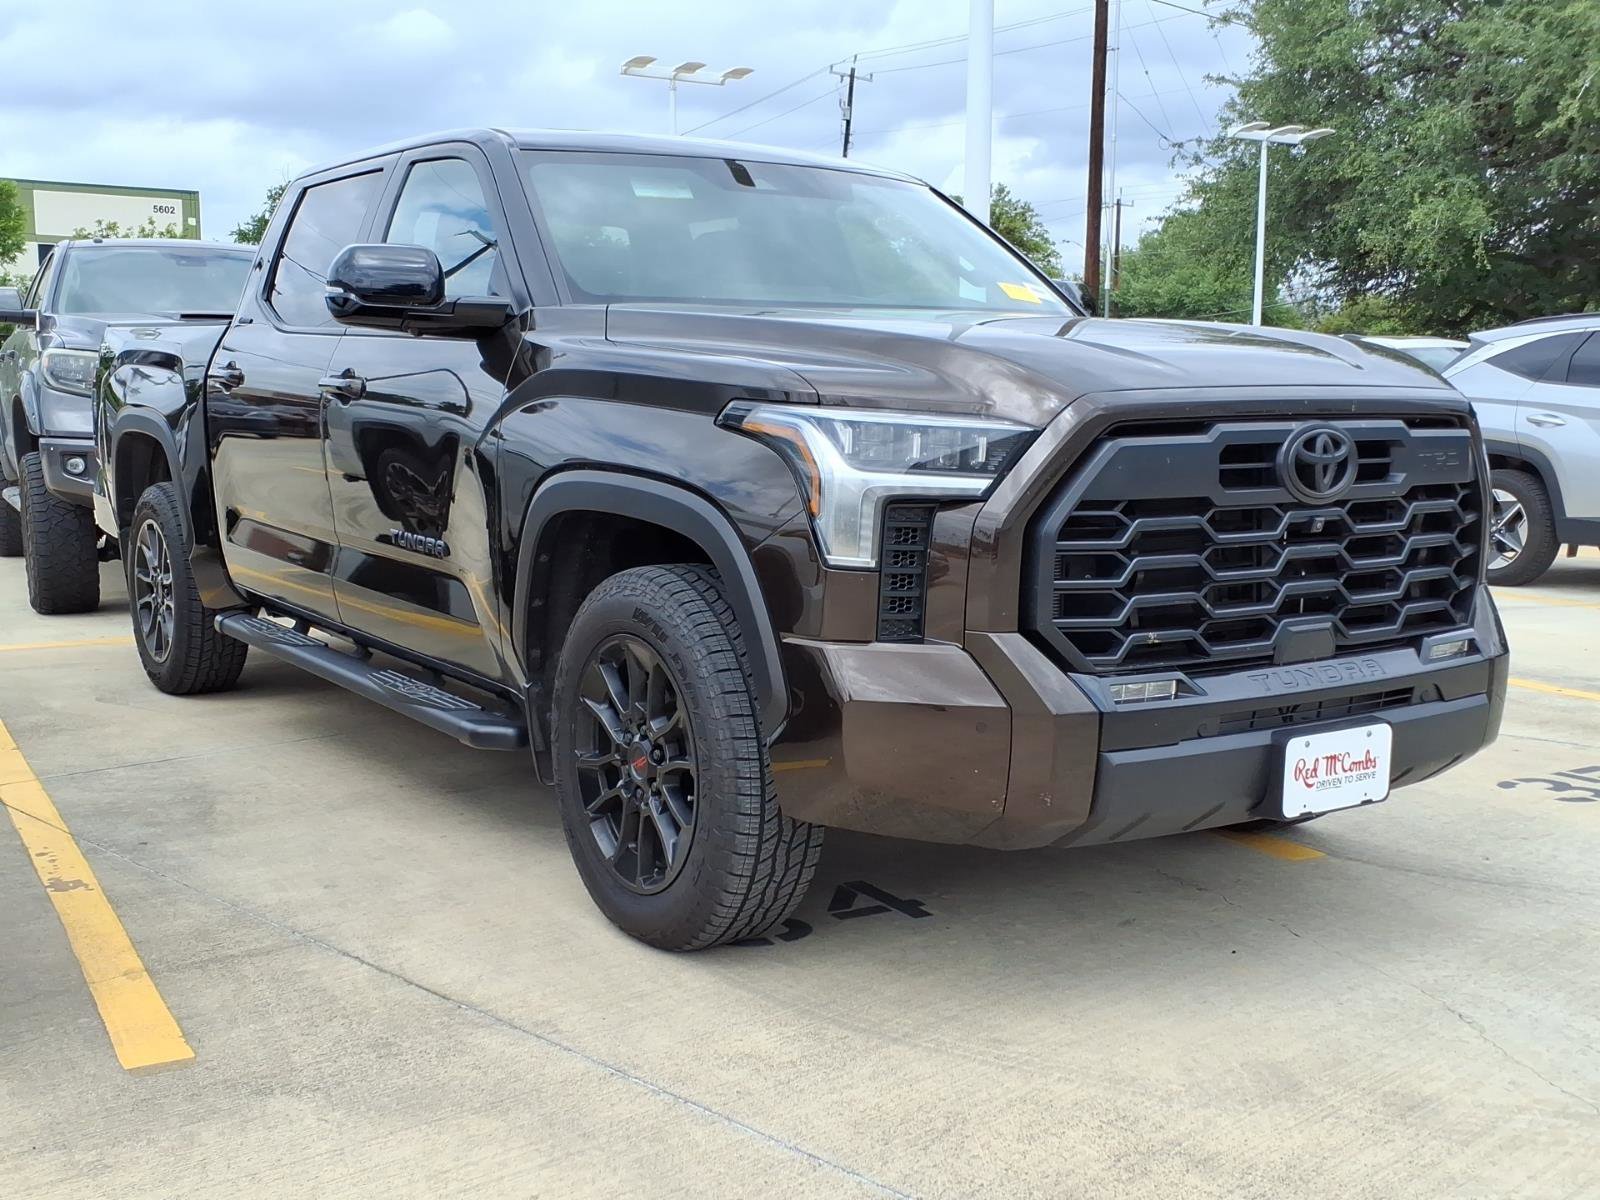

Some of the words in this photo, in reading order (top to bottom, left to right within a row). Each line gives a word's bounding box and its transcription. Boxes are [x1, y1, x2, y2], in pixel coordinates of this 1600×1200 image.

[153, 205, 176, 215] 5602
[390, 528, 444, 559] TUNDRA
[1247, 659, 1386, 692] TUNDRA
[1294, 758, 1319, 789] Red
[1322, 749, 1377, 777] McCombs
[1316, 777, 1342, 790] DRIVEN
[1344, 775, 1354, 784] TO
[1355, 771, 1377, 782] SERVE
